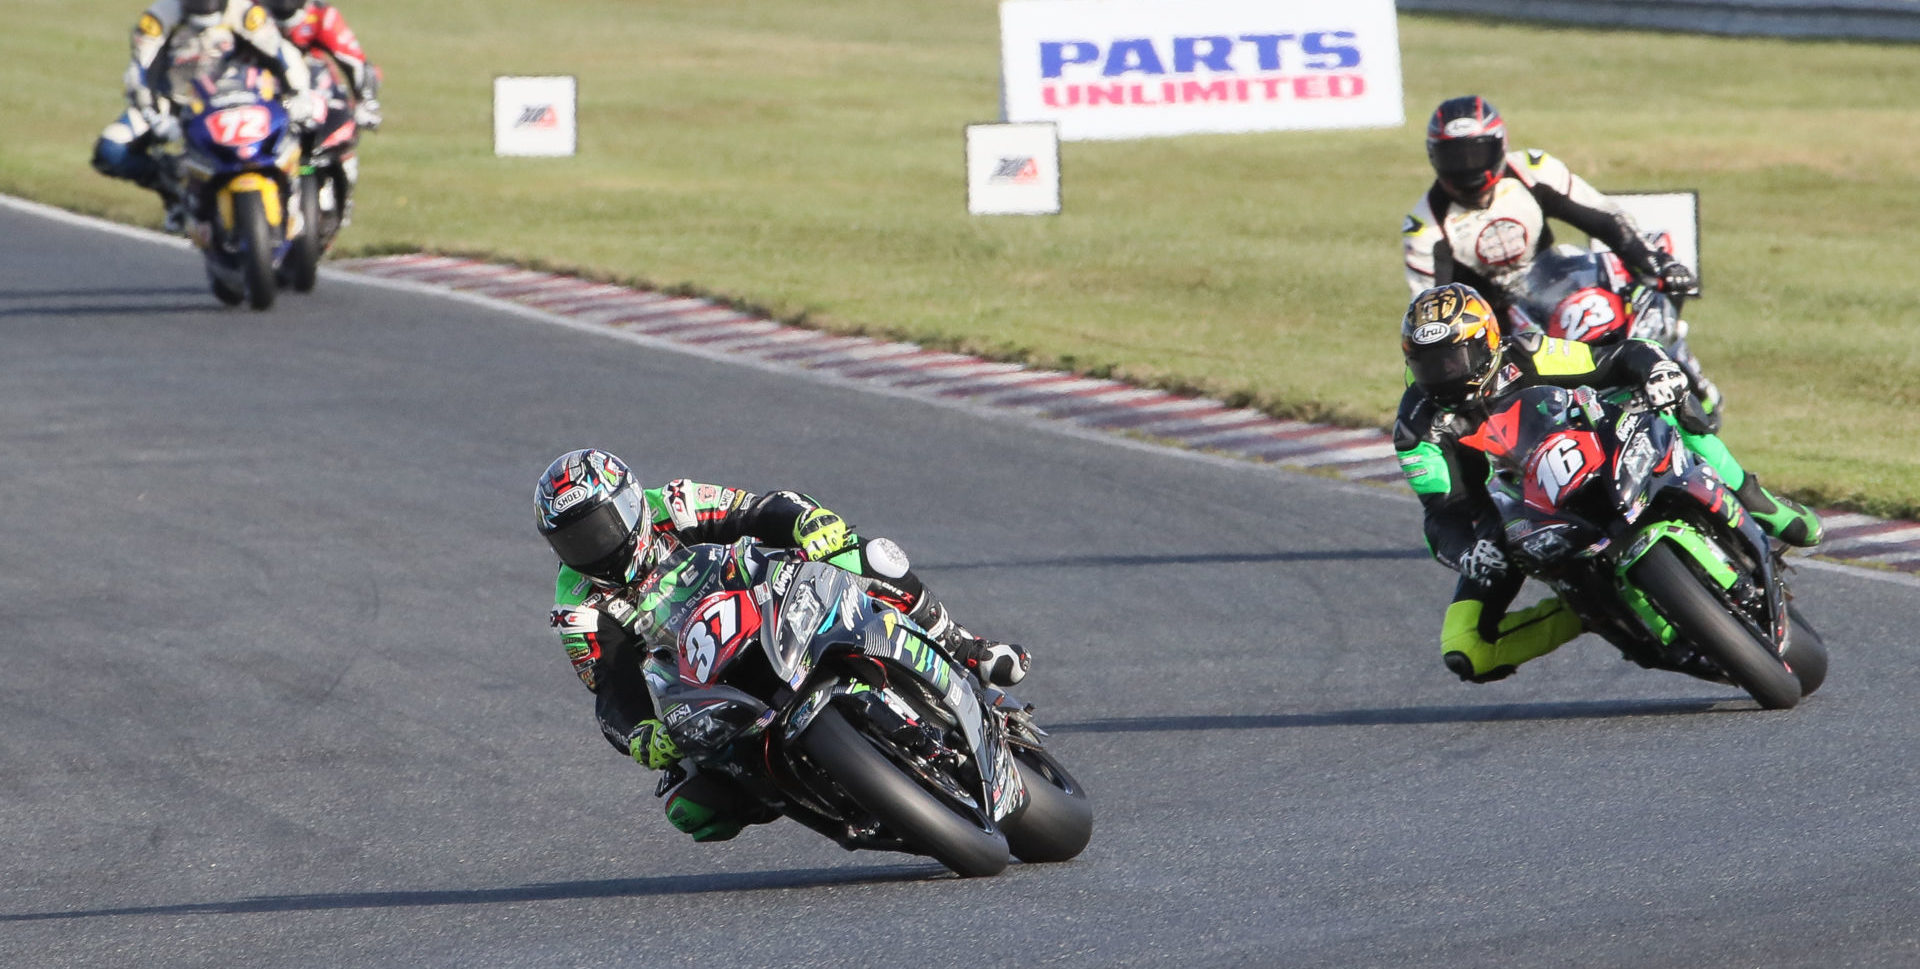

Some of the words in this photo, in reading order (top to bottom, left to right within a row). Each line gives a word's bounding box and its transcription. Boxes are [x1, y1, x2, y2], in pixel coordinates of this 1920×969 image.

[1040, 31, 1361, 78] PARTS
[1042, 74, 1365, 108] UNLIMITED
[218, 109, 267, 143] 72
[1415, 327, 1443, 341] Arai
[1560, 294, 1615, 341] 23
[1536, 438, 1584, 507] 16
[557, 490, 582, 509] SHOEI
[772, 563, 796, 597] Ninja
[686, 595, 738, 684] 37
